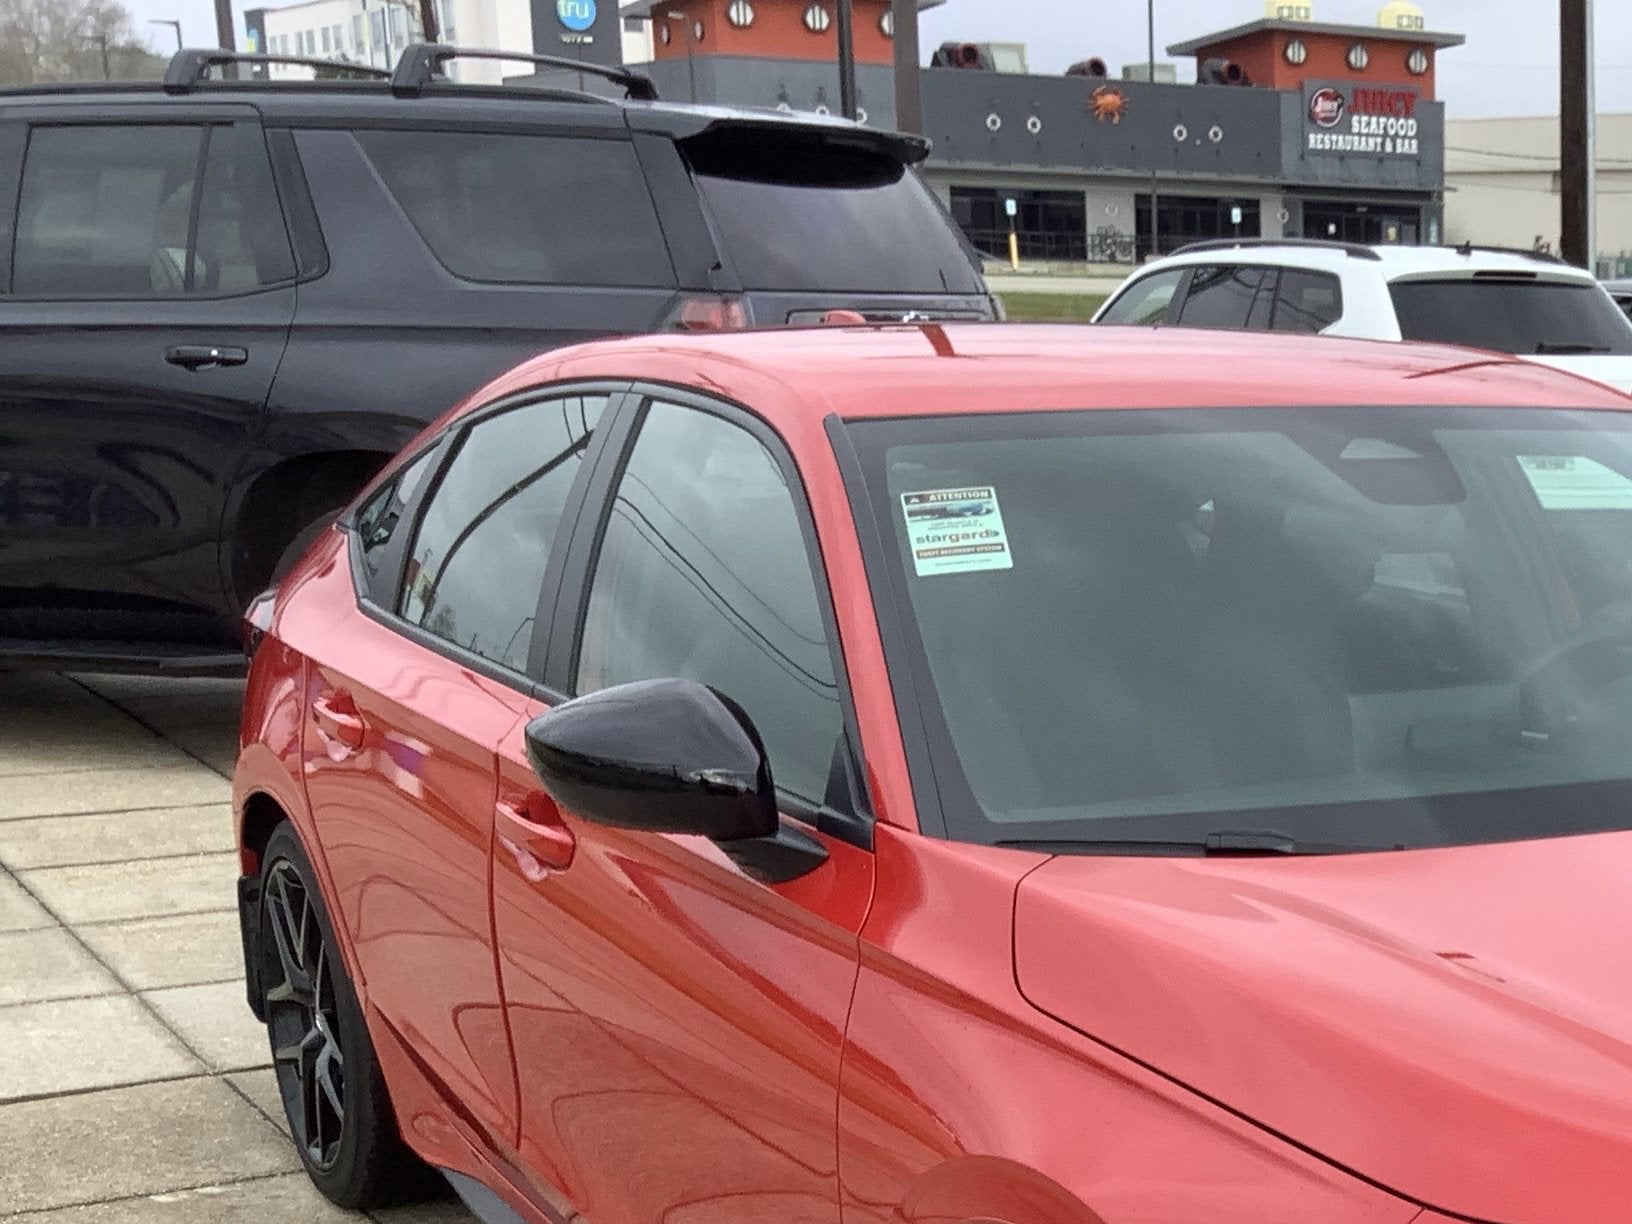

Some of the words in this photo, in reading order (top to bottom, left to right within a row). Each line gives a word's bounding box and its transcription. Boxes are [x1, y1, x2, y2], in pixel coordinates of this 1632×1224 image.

[1348, 87, 1416, 116] JUICY
[1351, 115, 1418, 137] SEAFOOD
[1308, 132, 1382, 153] RESTAURANT
[1384, 138, 1393, 154] &
[1395, 138, 1418, 155] BAR
[929, 489, 989, 503] ATTENTION
